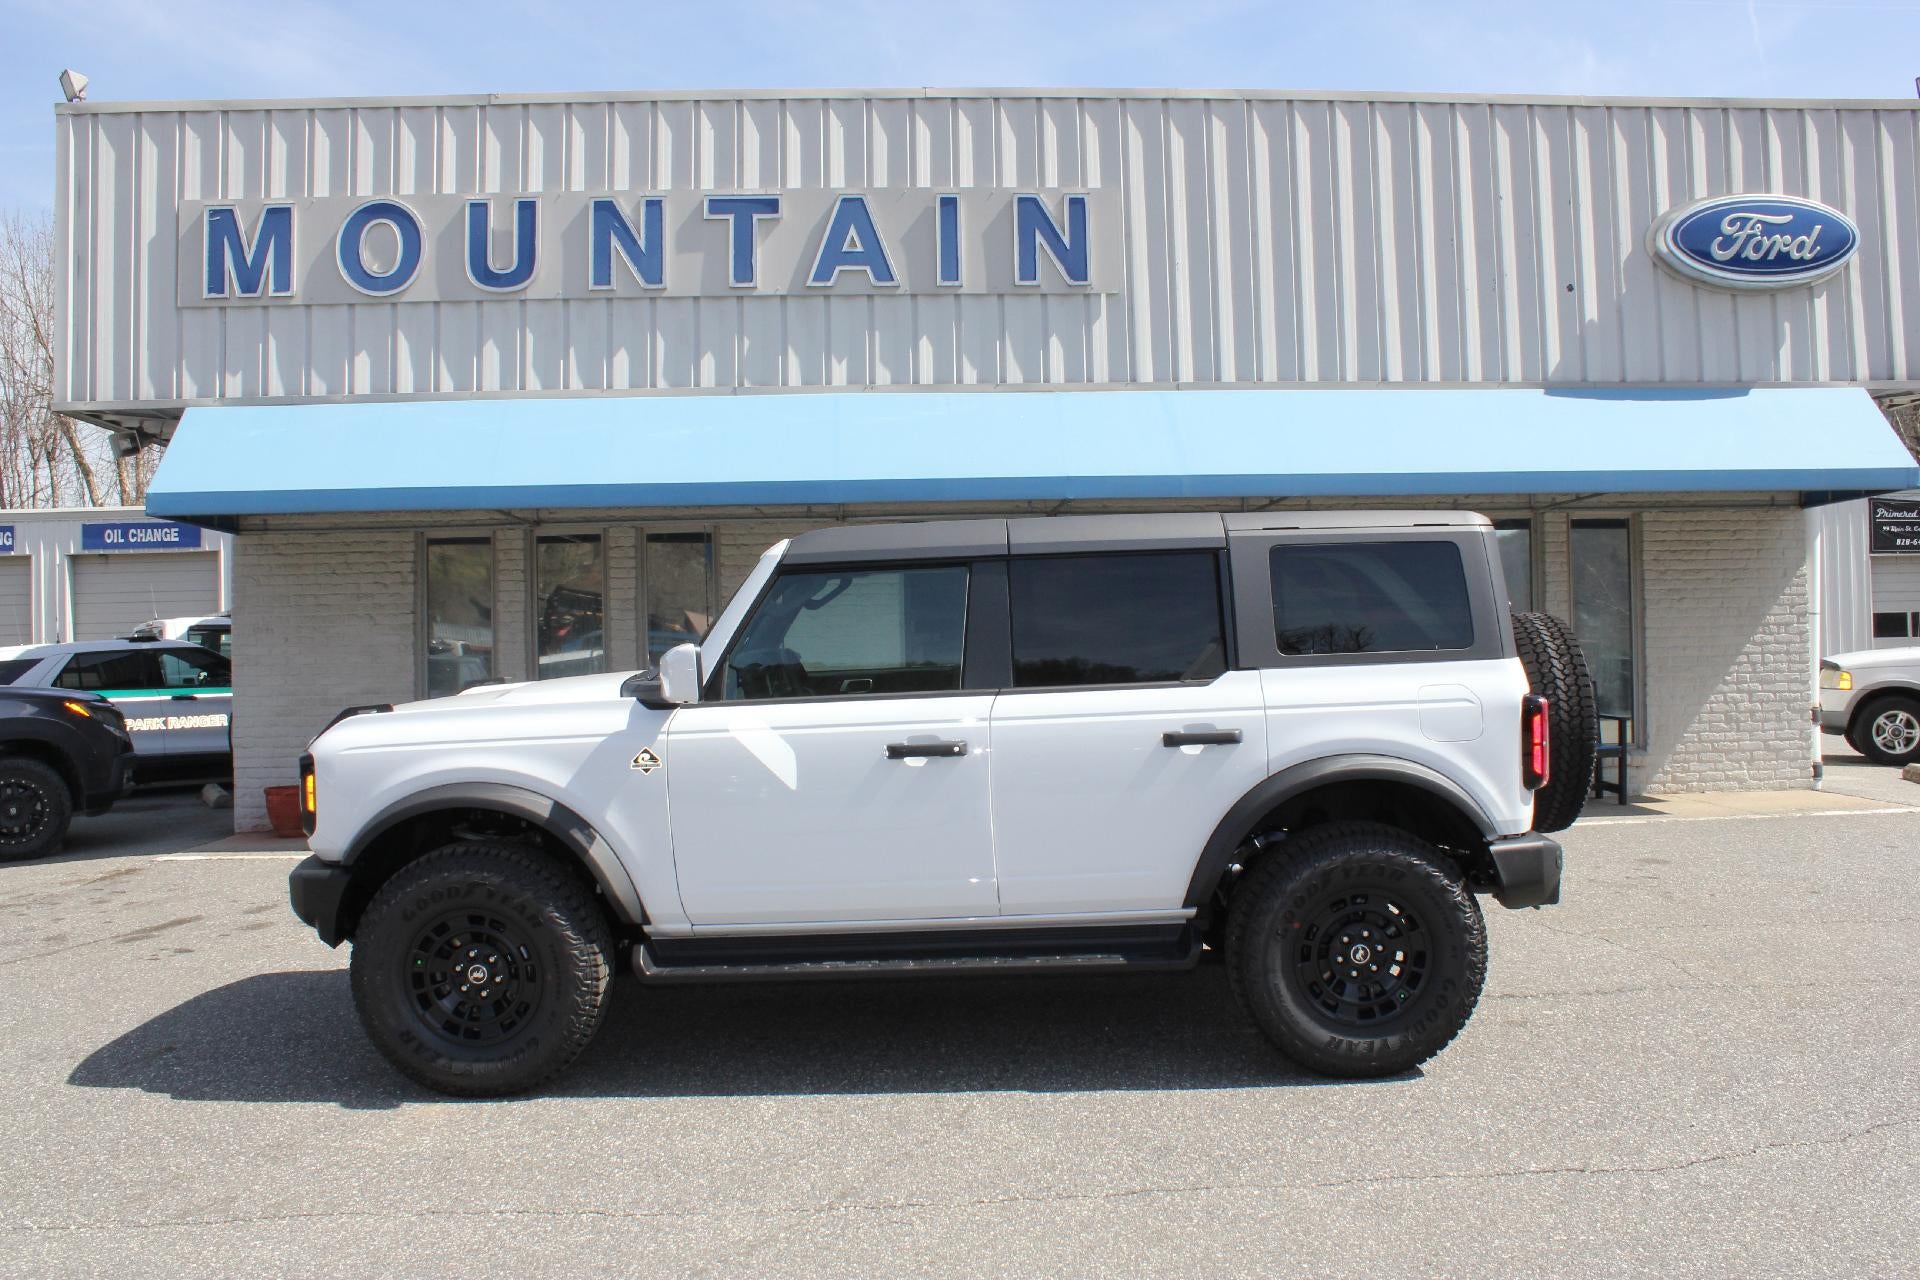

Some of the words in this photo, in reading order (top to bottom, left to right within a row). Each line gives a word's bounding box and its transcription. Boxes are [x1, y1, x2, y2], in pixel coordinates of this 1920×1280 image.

[202, 193, 1093, 298] MOUNTAIN
[1711, 212, 1822, 261] Ford
[104, 528, 125, 544] OIL
[128, 527, 180, 542] CHANGE
[125, 717, 167, 732] PARK
[167, 713, 229, 730] RANGER
